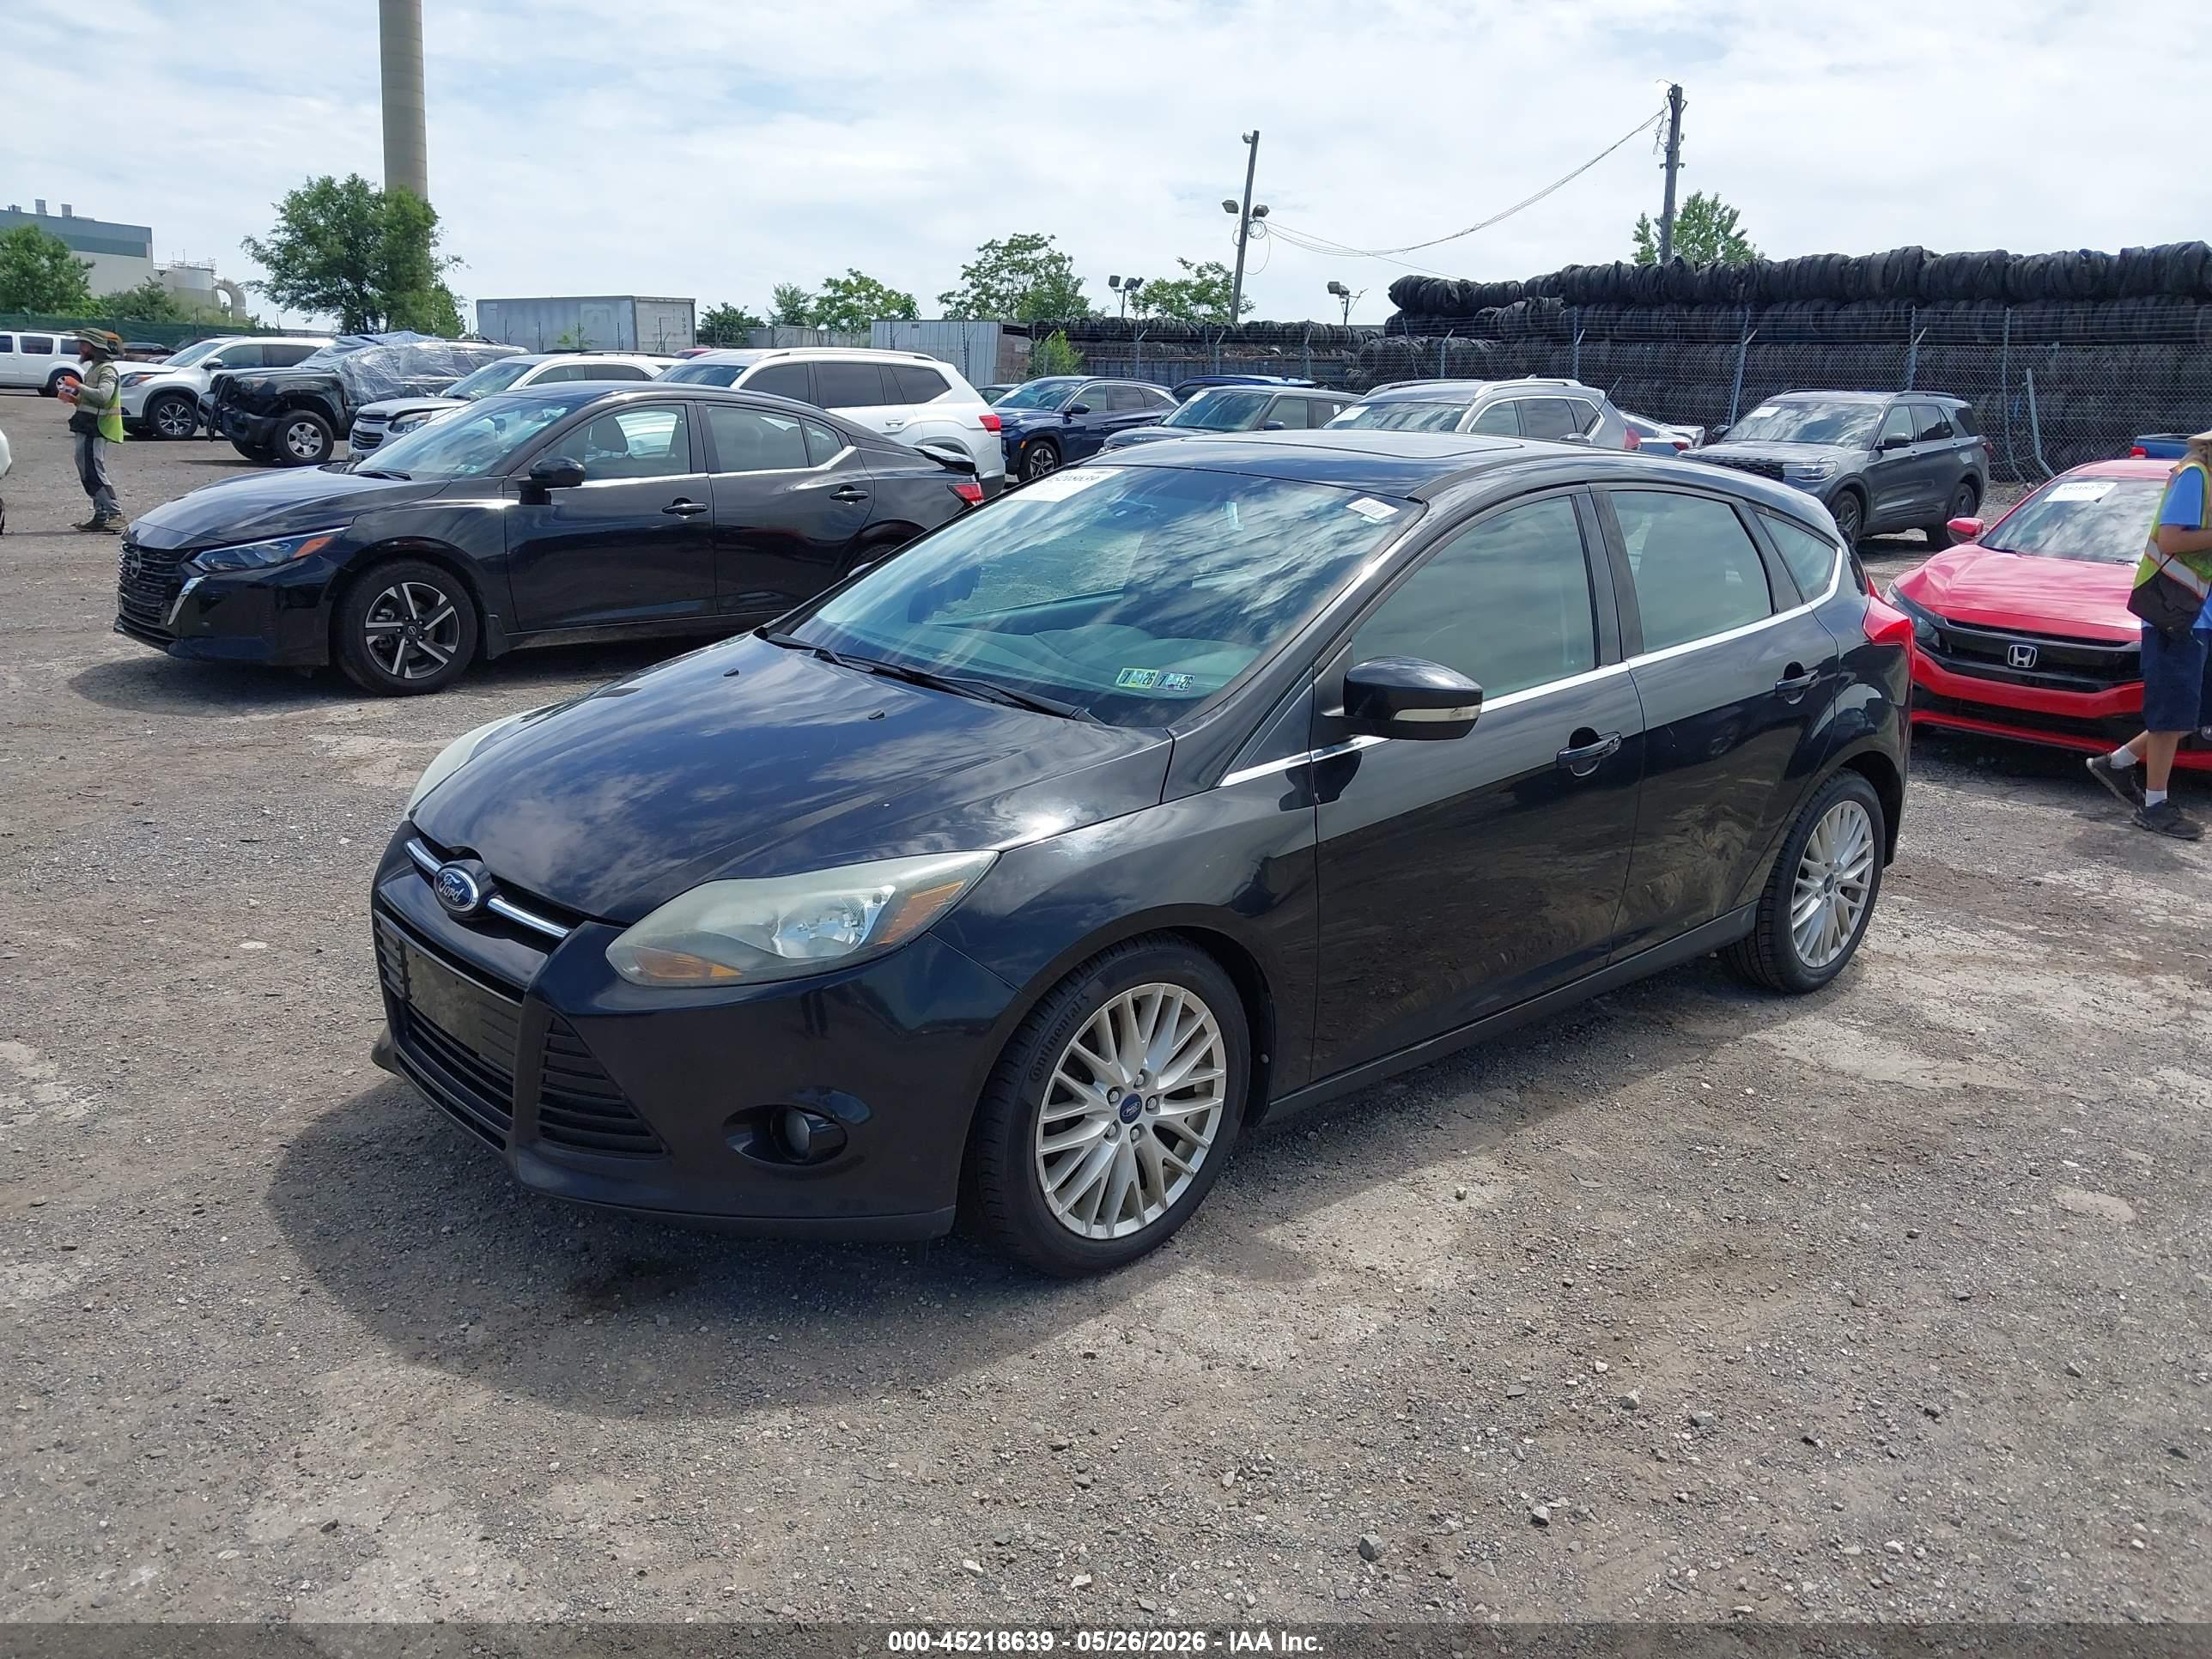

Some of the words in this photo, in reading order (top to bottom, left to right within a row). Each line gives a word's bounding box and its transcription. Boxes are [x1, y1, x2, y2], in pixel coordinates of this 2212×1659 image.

[1122, 672, 1131, 684] 7
[1142, 672, 1156, 687] 26
[1158, 674, 1168, 686] 7
[439, 873, 465, 902] Ford
